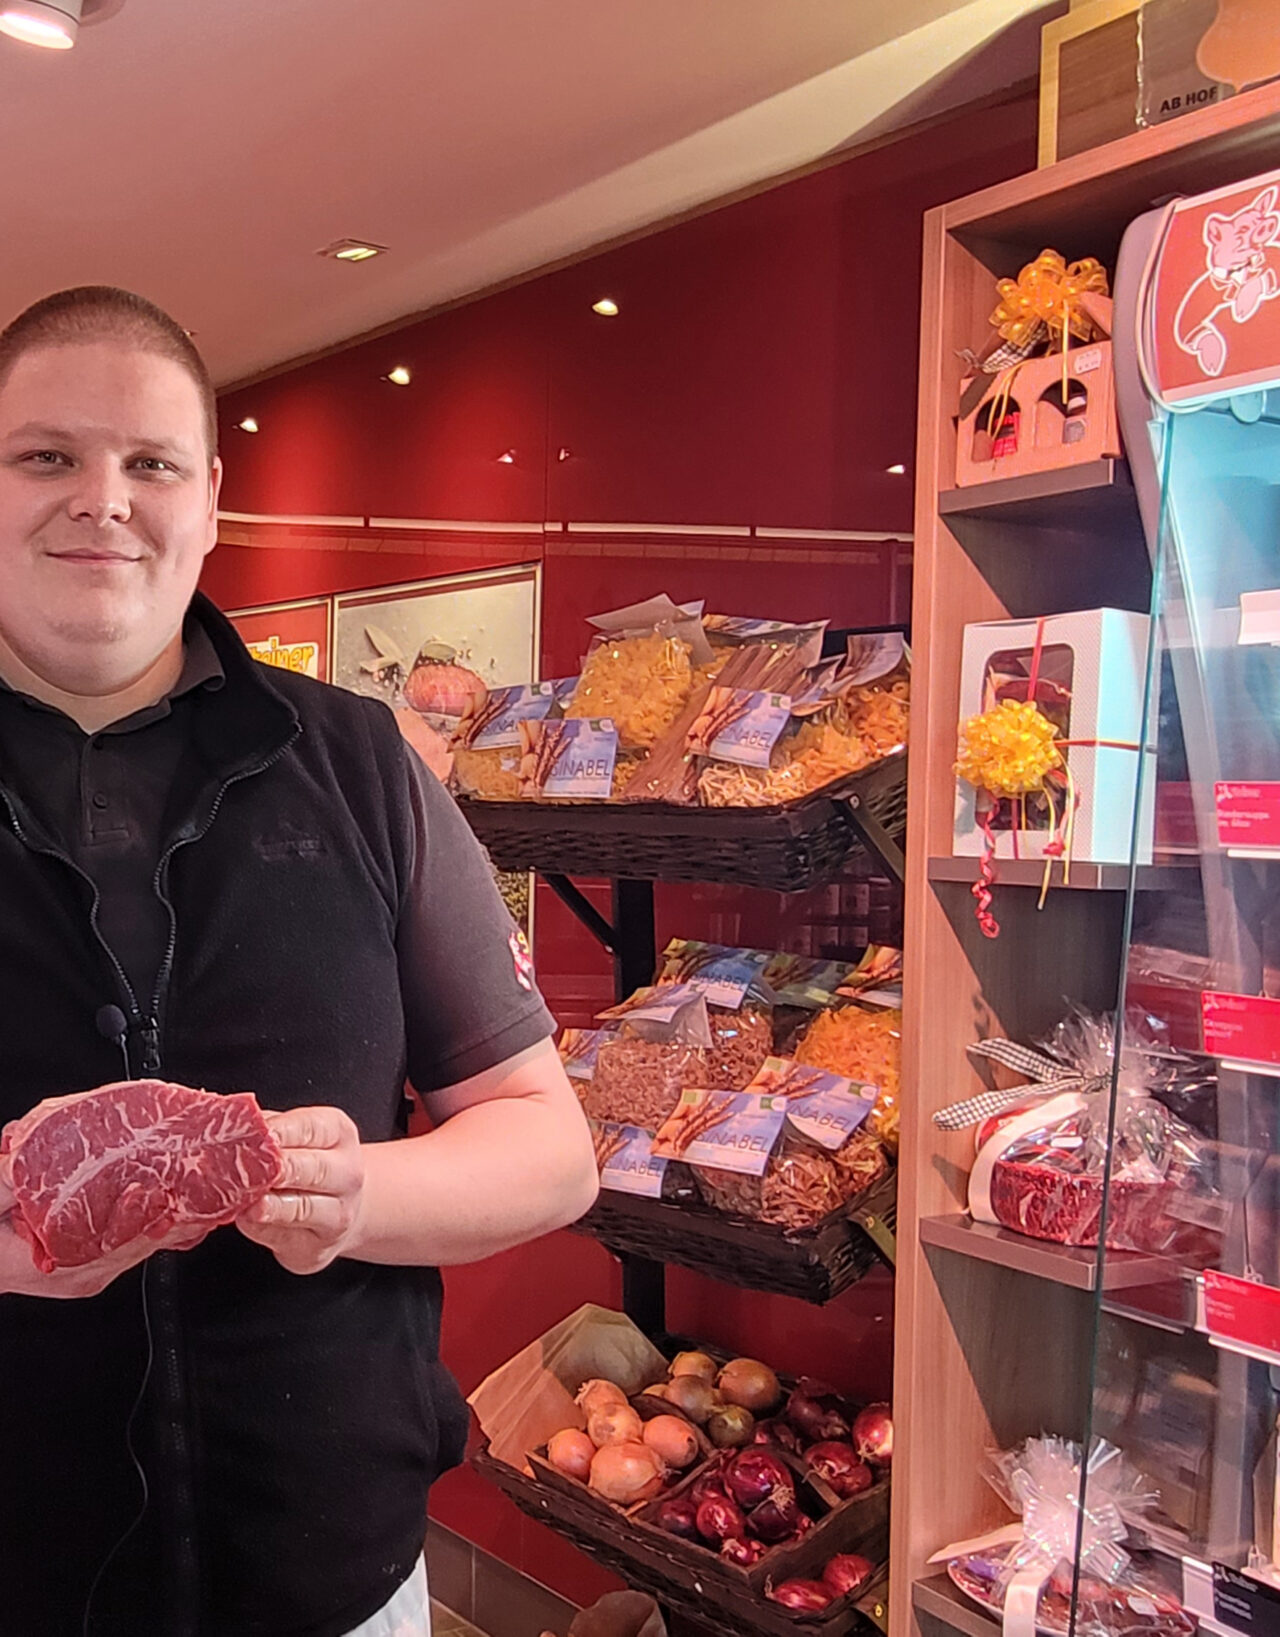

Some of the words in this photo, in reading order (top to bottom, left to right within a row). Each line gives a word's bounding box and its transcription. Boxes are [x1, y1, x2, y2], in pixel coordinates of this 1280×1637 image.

[1160, 97, 1181, 113] AB
[1186, 86, 1217, 106] HOF
[551, 758, 611, 777] SINABEL
[787, 1103, 853, 1133] INABEL
[695, 1130, 769, 1154] SINABEL
